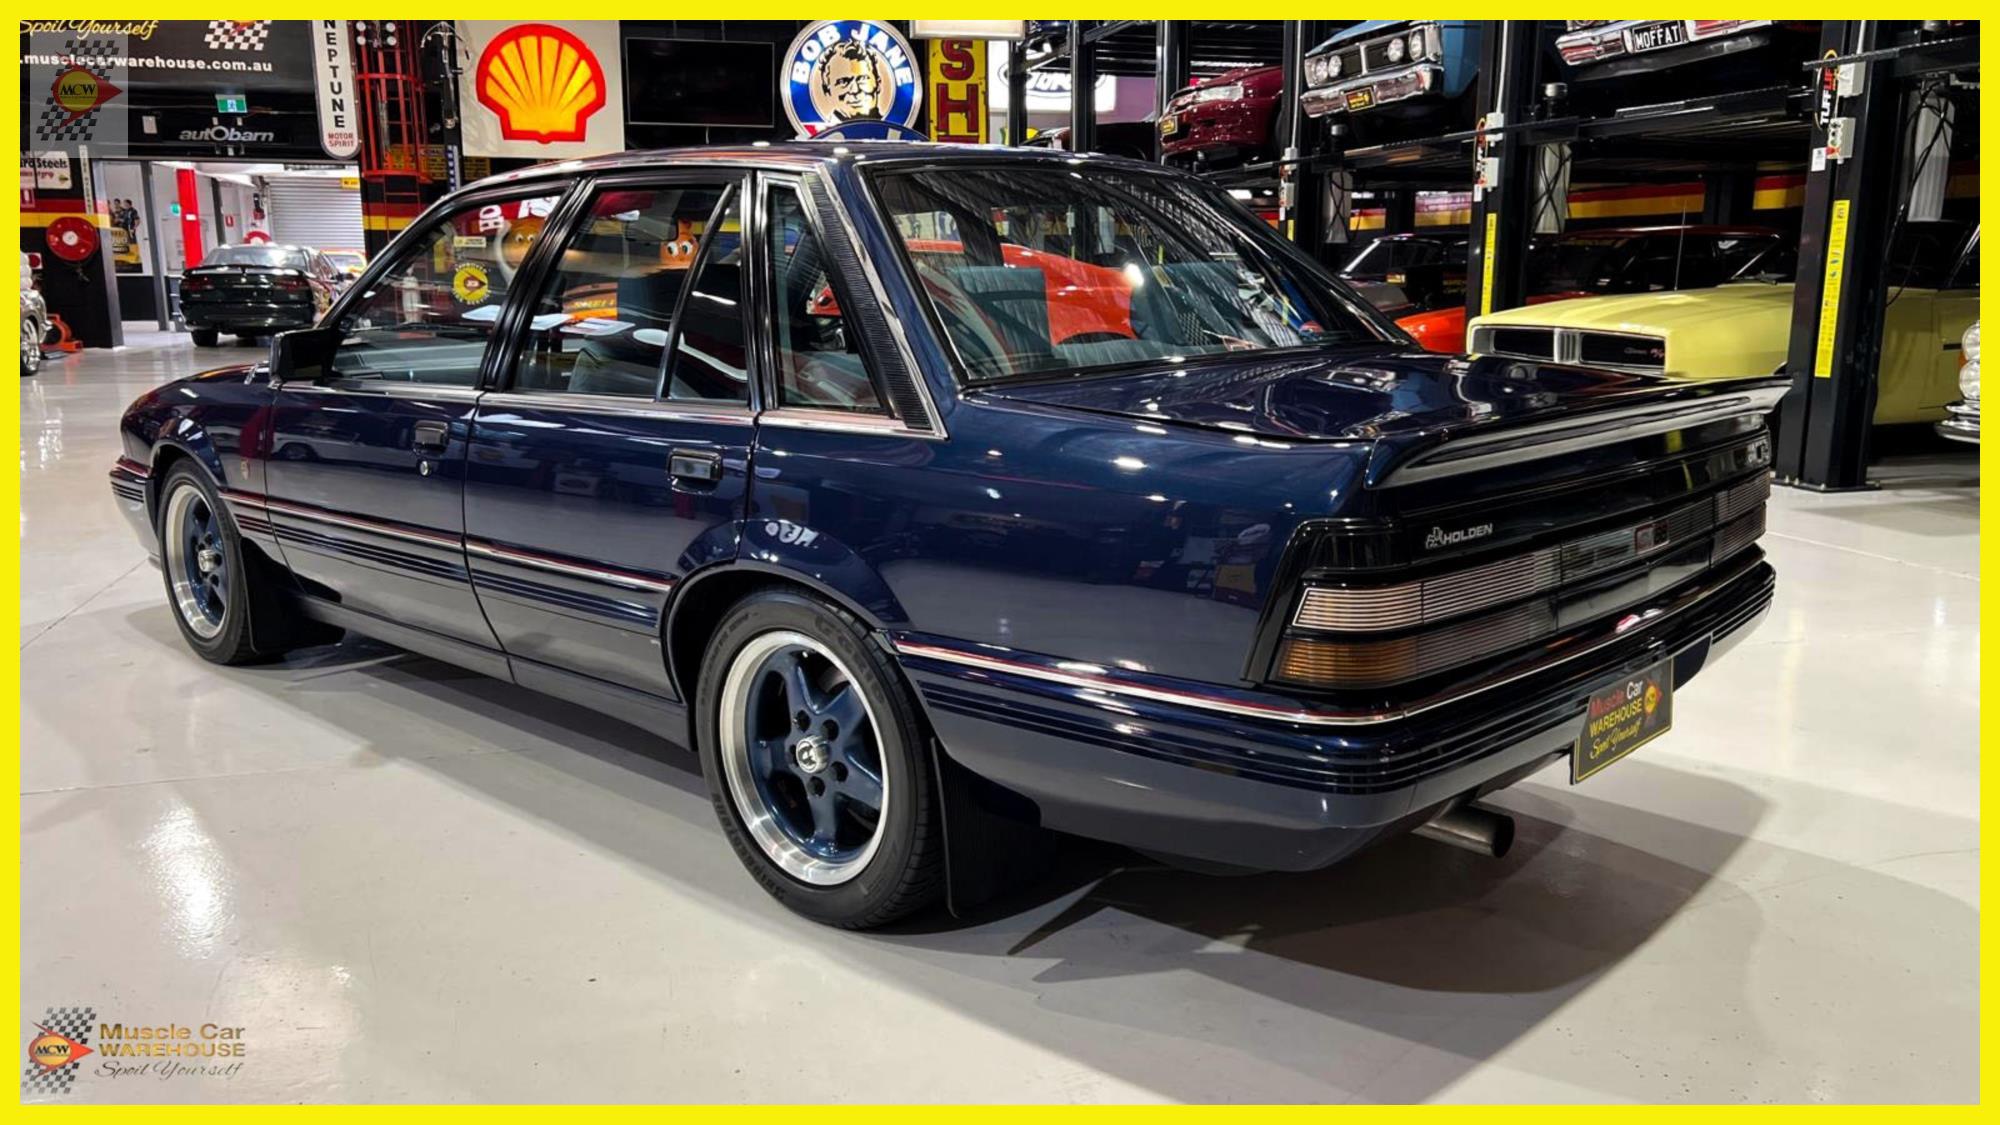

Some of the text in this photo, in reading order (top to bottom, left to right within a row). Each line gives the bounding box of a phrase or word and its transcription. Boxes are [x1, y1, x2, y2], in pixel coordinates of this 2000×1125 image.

[68, 20, 159, 40] Yourself
[1634, 25, 1680, 49] MOFFAT
[791, 23, 912, 86] BOB JANE
[323, 20, 346, 128] NEPTUNE
[936, 40, 979, 143] SH
[1820, 89, 1832, 126] TUFF
[1443, 523, 1493, 545] HOLDEN
[1626, 680, 1643, 700] Car
[1589, 698, 1642, 737] WAREHOUSE
